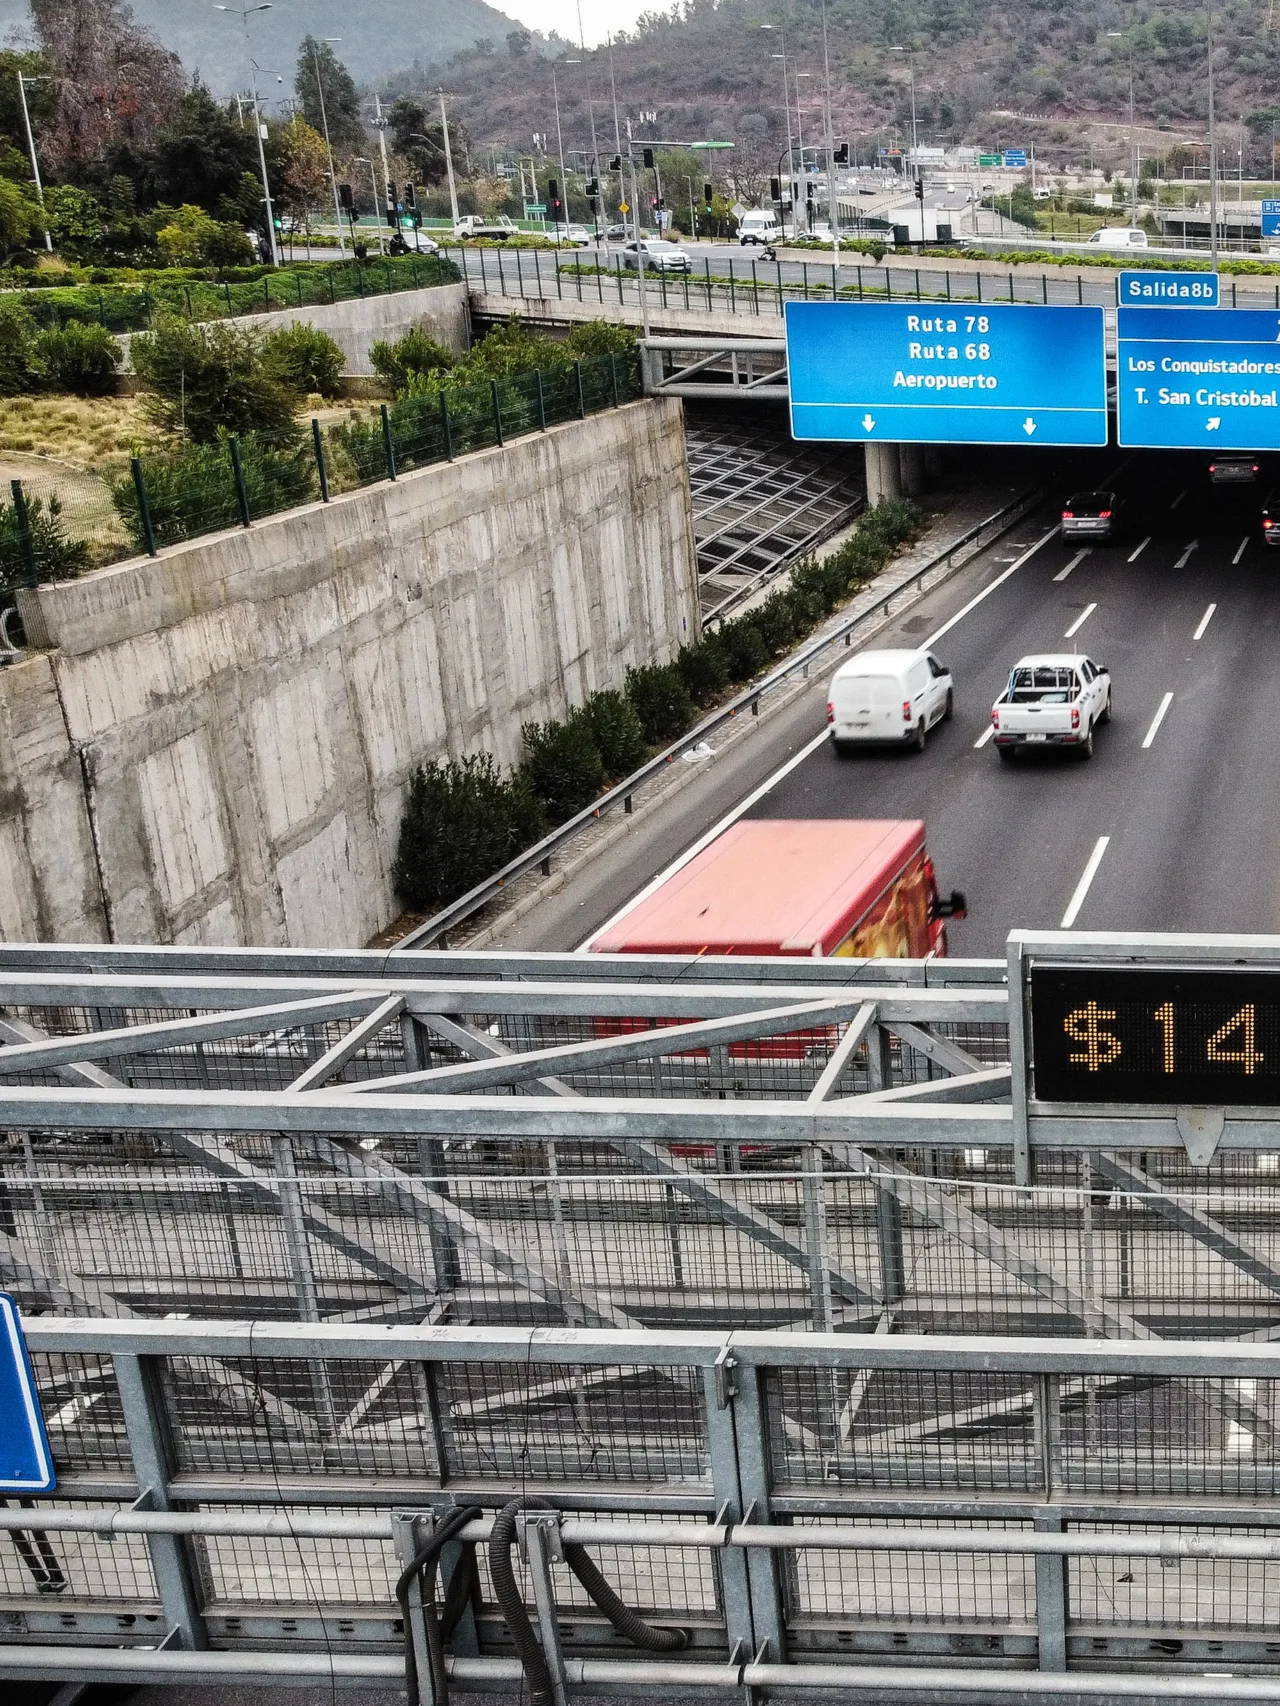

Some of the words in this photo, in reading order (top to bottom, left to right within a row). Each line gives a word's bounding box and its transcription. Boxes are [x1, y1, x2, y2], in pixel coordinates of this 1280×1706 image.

[907, 315, 957, 333] Ruta
[964, 316, 989, 333] 78
[909, 342, 958, 360] Ruta
[965, 343, 990, 360] 68
[1128, 356, 1155, 373] Los
[893, 371, 997, 390] Aeropuerto
[1135, 387, 1149, 404] T.
[1158, 387, 1190, 405] San
[1196, 388, 1278, 407] Cristóbal
